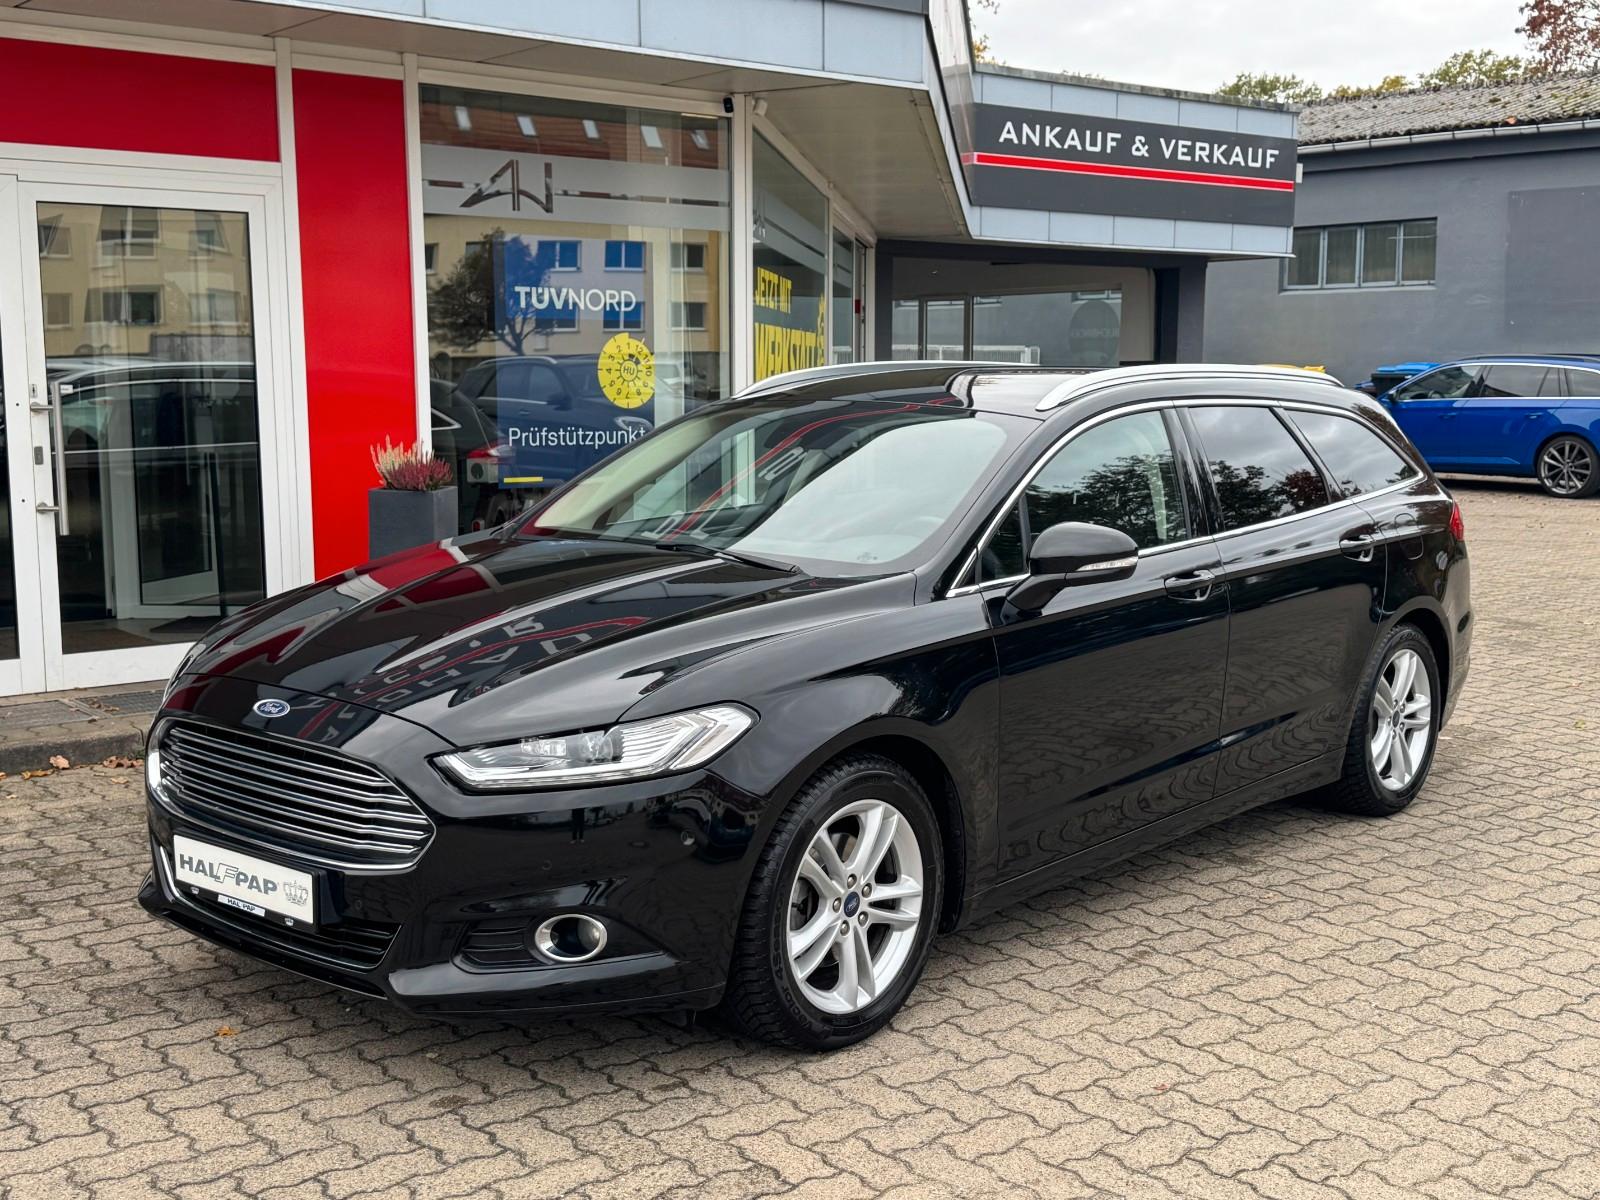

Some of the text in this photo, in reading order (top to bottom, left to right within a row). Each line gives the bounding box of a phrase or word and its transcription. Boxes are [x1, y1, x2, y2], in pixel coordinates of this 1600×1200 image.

[998, 121, 1280, 169] ANKAUF & VERKAUF
[755, 266, 792, 314] JETZT MIT
[508, 426, 647, 450] Prüfstützpunkt
[179, 853, 279, 895] HALFPAP
